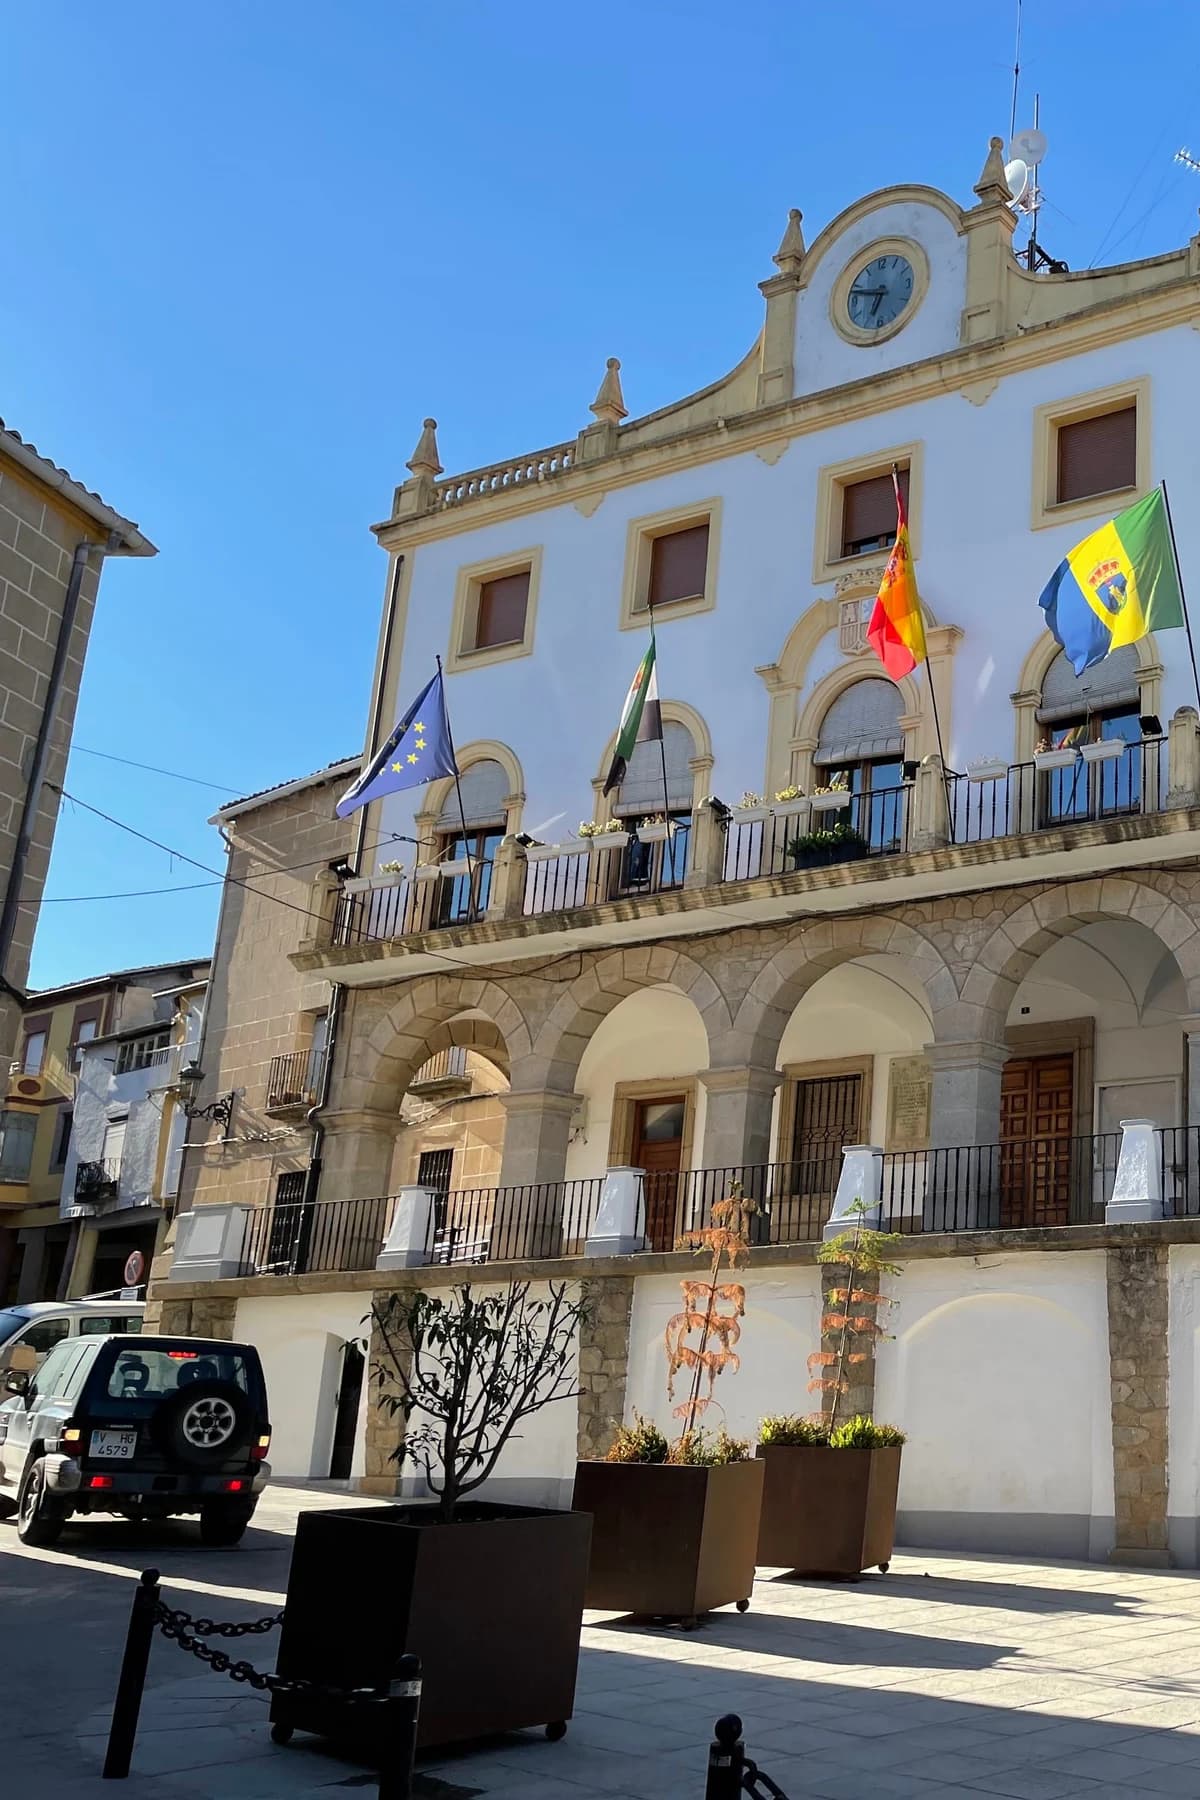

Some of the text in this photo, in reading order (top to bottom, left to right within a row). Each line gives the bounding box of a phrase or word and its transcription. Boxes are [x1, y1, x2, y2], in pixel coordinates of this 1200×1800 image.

[879, 258, 886, 269] 12
[905, 278, 911, 289] 3
[100, 1432, 134, 1444] V HG
[98, 1445, 128, 1456] 4579
